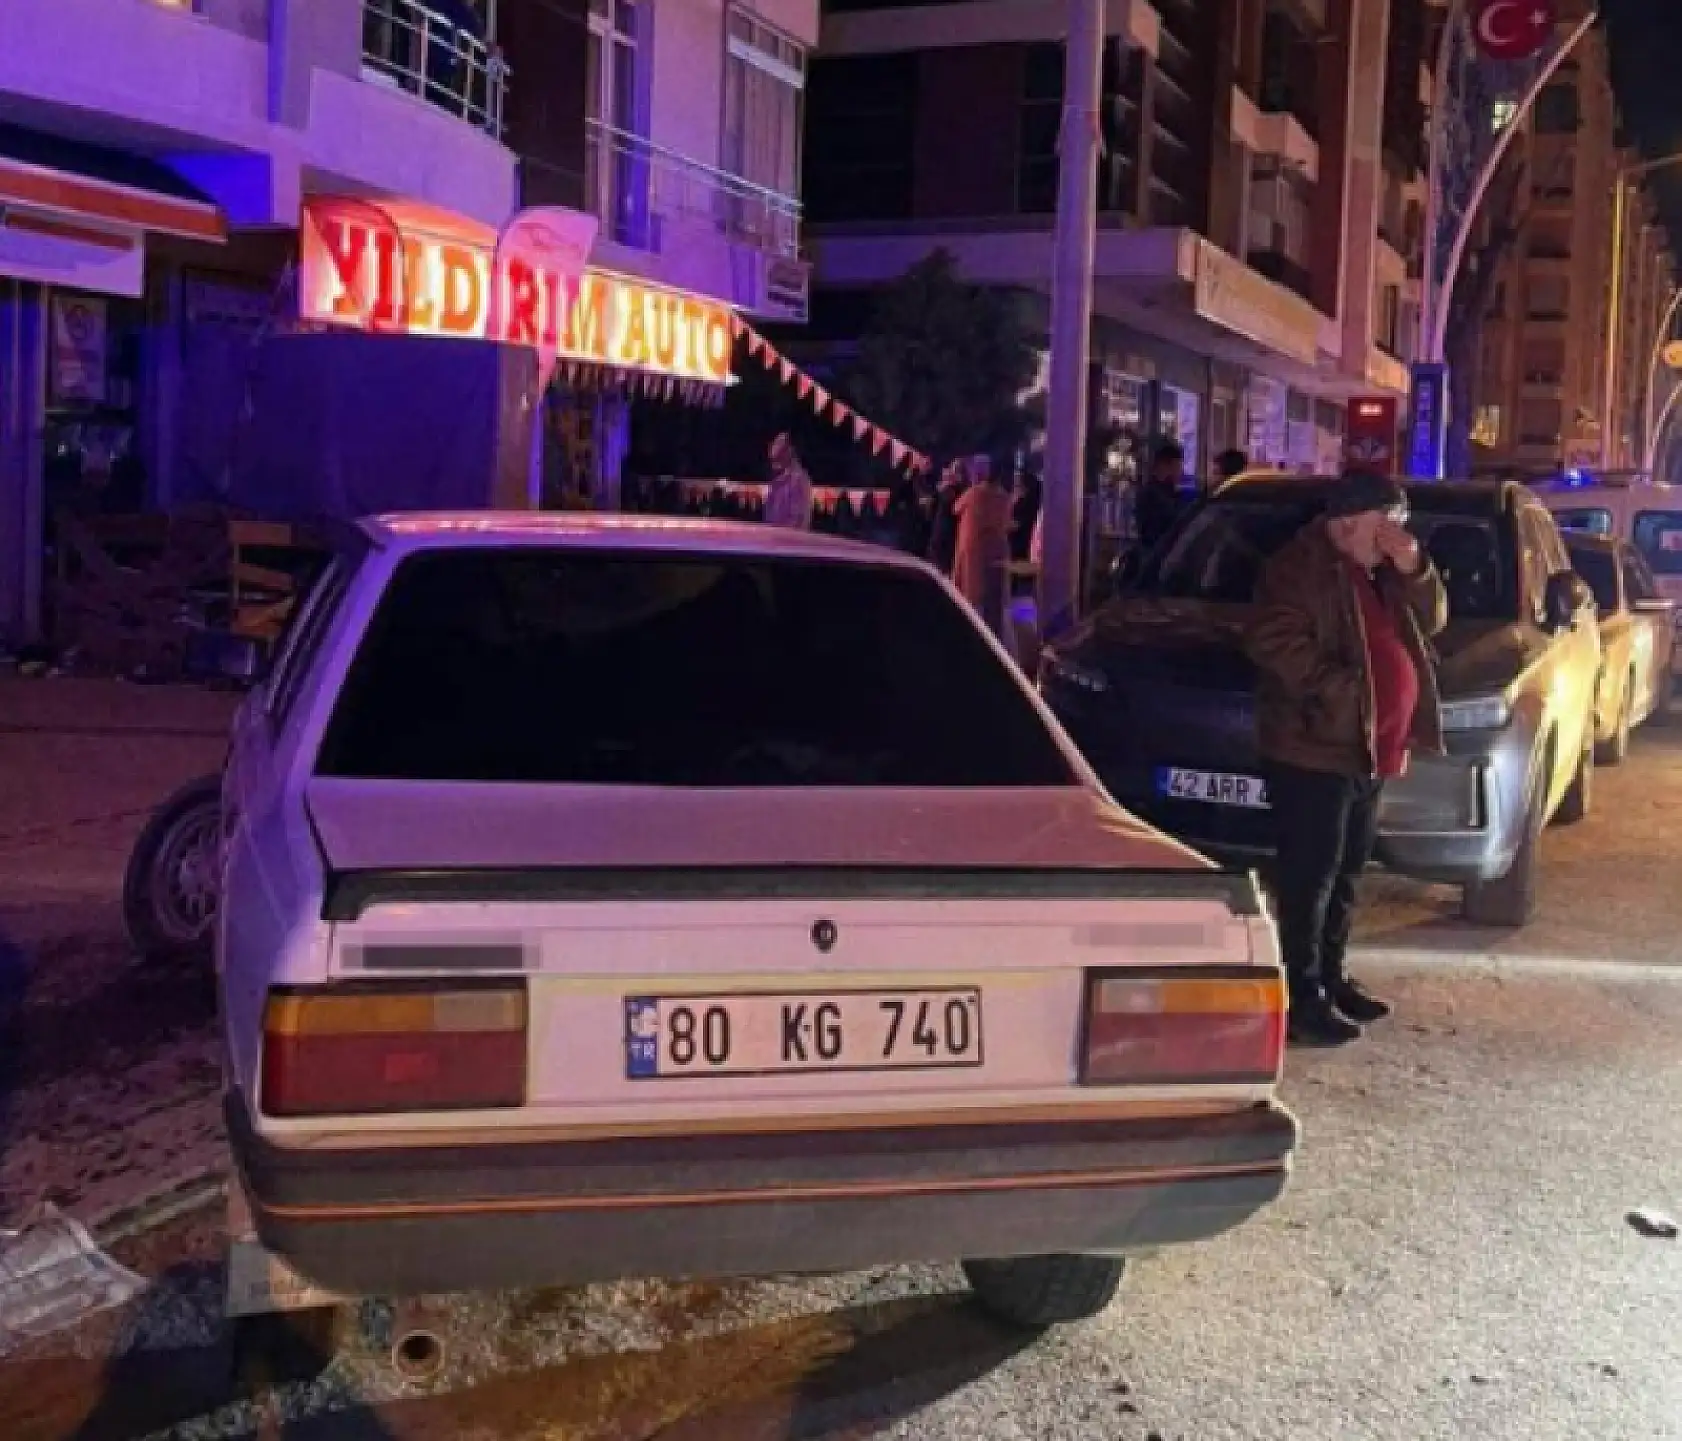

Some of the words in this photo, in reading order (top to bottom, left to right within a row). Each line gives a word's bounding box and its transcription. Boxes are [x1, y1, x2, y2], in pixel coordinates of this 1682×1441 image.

[322, 218, 606, 354] YILDRIM
[620, 285, 728, 376] AUTO
[1171, 771, 1197, 797] 42
[669, 1006, 730, 1065] 80
[781, 1001, 842, 1062] KG
[879, 1000, 969, 1056] 740
